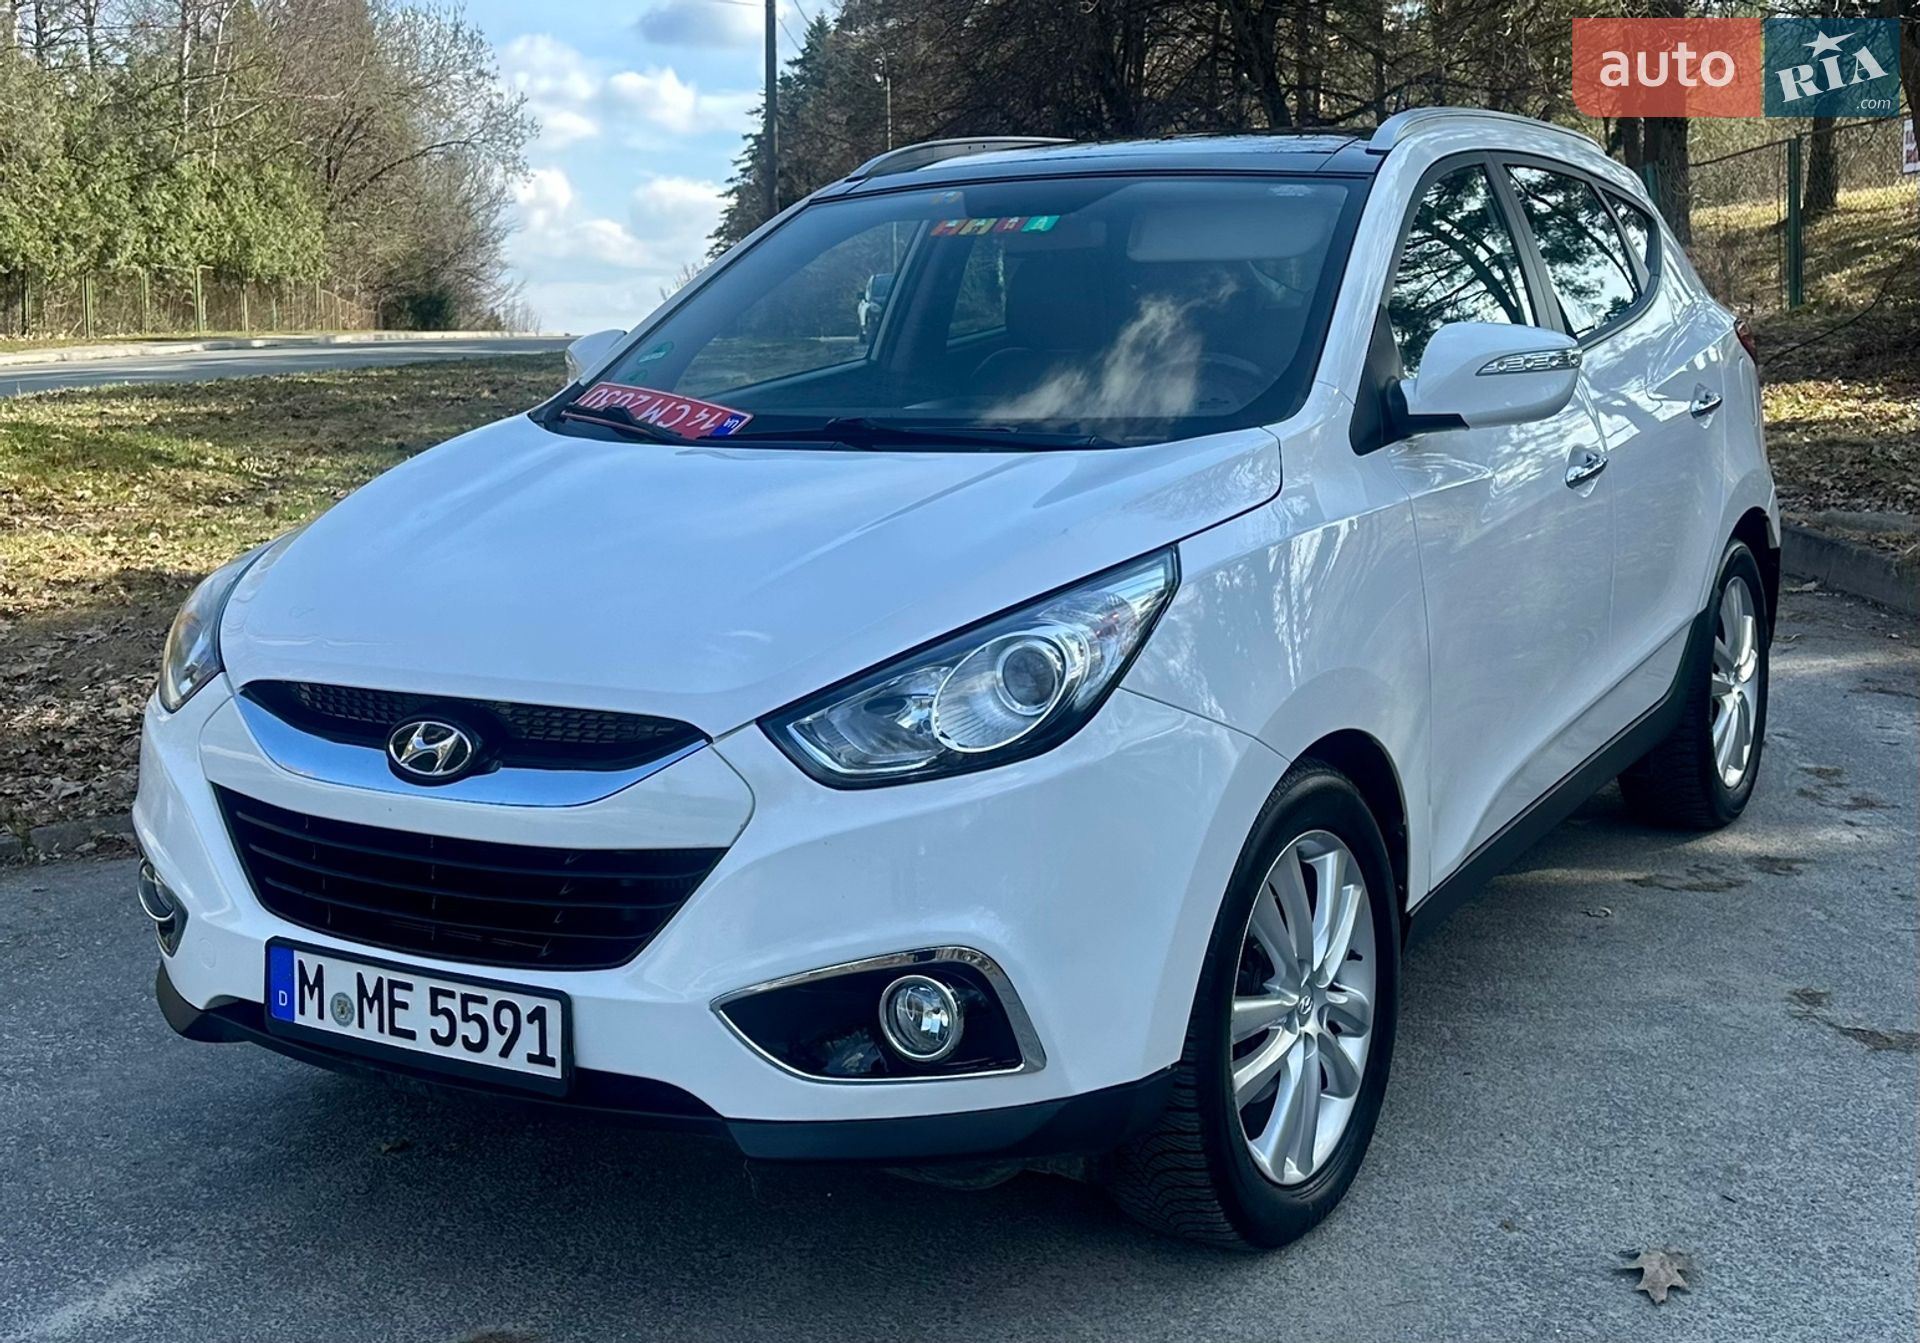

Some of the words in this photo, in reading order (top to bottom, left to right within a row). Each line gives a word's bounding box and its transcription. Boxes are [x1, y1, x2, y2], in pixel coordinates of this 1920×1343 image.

[636, 398, 691, 428] CM
[686, 407, 722, 430] 14
[278, 989, 288, 1007] D
[298, 958, 325, 1020] M
[356, 971, 417, 1041] ME
[429, 985, 556, 1068] 5591
